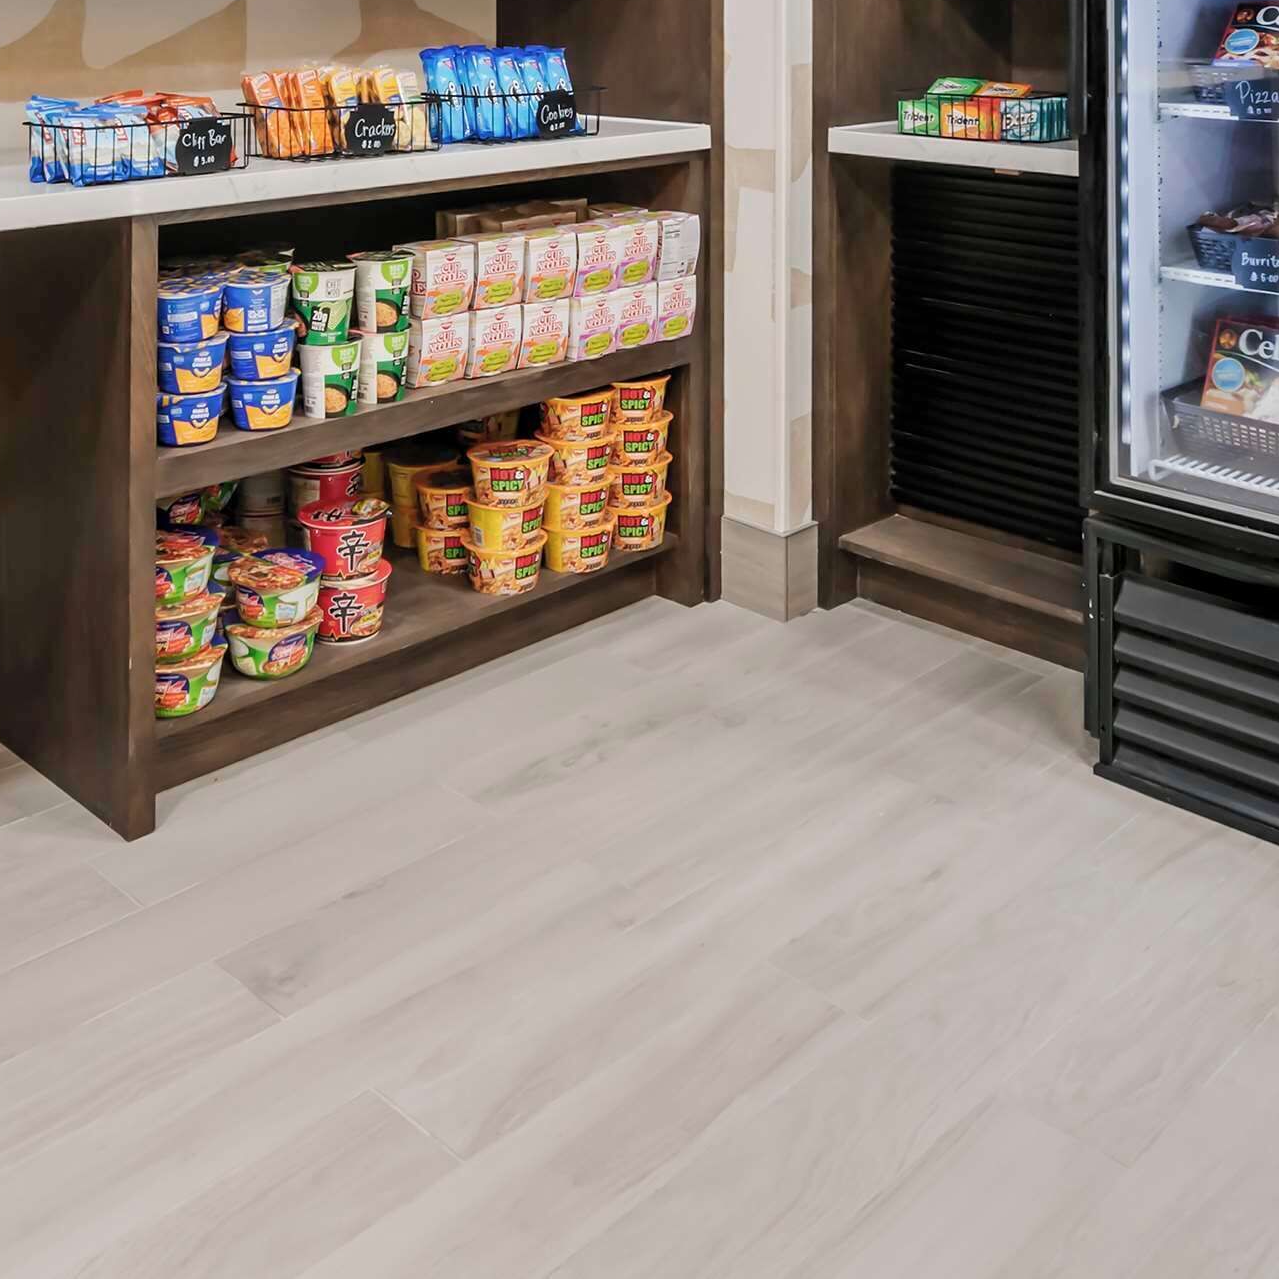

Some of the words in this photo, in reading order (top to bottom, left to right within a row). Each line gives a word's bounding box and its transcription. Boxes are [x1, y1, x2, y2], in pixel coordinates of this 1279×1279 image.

[902, 110, 935, 123] Trident
[946, 114, 979, 126] Trident
[208, 128, 227, 147] Bar
[492, 252, 513, 265] CUP
[544, 249, 565, 261] CUP
[441, 261, 461, 274] CUP
[489, 320, 510, 332] CUP
[536, 313, 558, 326] CUP
[436, 329, 457, 342] CUP
[621, 400, 650, 411] SPICY
[581, 414, 606, 427] SPICY
[625, 442, 654, 453] SPICY
[491, 480, 525, 492] SPICY
[624, 484, 652, 496] SPICY
[447, 505, 468, 516] SPI
[580, 501, 605, 515] SPICY
[522, 520, 541, 534] SPIC
[620, 526, 649, 538] SPICY
[337, 529, 370, 572] 辛
[581, 544, 607, 558] SPICY
[515, 567, 537, 580] SPIC
[329, 592, 363, 635] 辛
